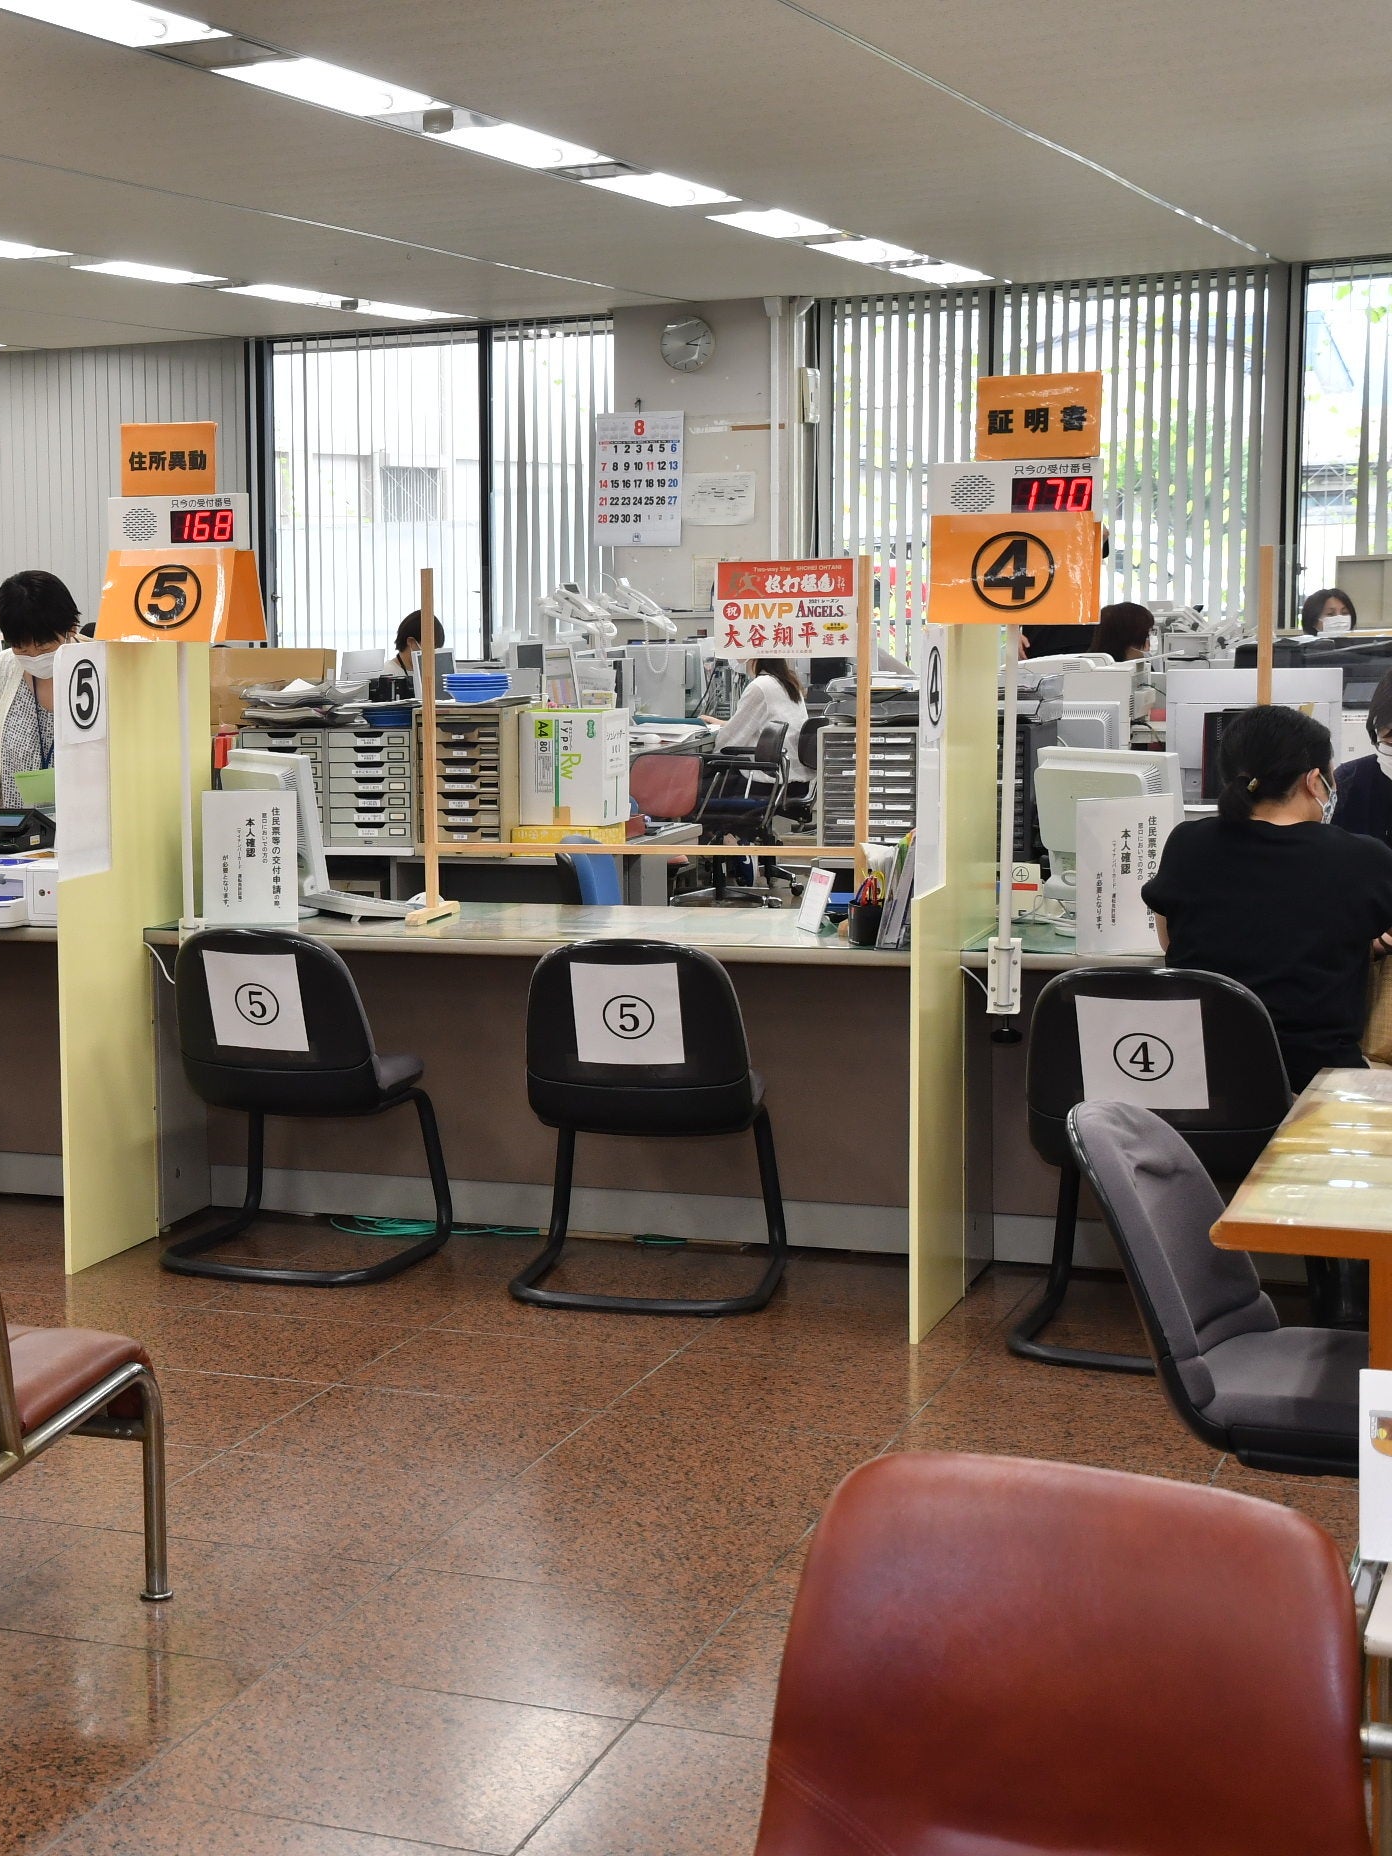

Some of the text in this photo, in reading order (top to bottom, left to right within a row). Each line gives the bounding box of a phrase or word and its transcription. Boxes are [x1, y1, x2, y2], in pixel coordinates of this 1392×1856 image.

[634, 419, 645, 436] 8
[987, 405, 1088, 436] 証明書
[613, 443, 677, 453] 1 2 3 4 5 6
[128, 450, 207, 471] 住所異動
[601, 461, 678, 471] 7 8 9 10 11 12 13
[1013, 463, 1092, 475] 只今の受付番号
[599, 479, 678, 488] 14 15 16 17 18 19 20
[171, 497, 231, 508] 只今の受付番号
[599, 496, 677, 506] 21 22 23 24 25 26 27
[1026, 478, 1092, 512] 170
[182, 511, 233, 541] 168
[598, 515, 607, 524] 28
[609, 515, 619, 524] 29
[621, 515, 630, 523] 30
[633, 515, 641, 523] 31
[743, 602, 793, 619] MVP
[795, 600, 844, 618] ANGELS
[724, 621, 850, 648] 大谷翔平 選手
[538, 720, 548, 737] A4
[539, 741, 547, 752] 80
[561, 720, 581, 780] Type Rw
[246, 817, 256, 858] 本人確認
[1120, 828, 1131, 875] 本人確認
[1147, 815, 1157, 932] 住民票等の交請の際、
